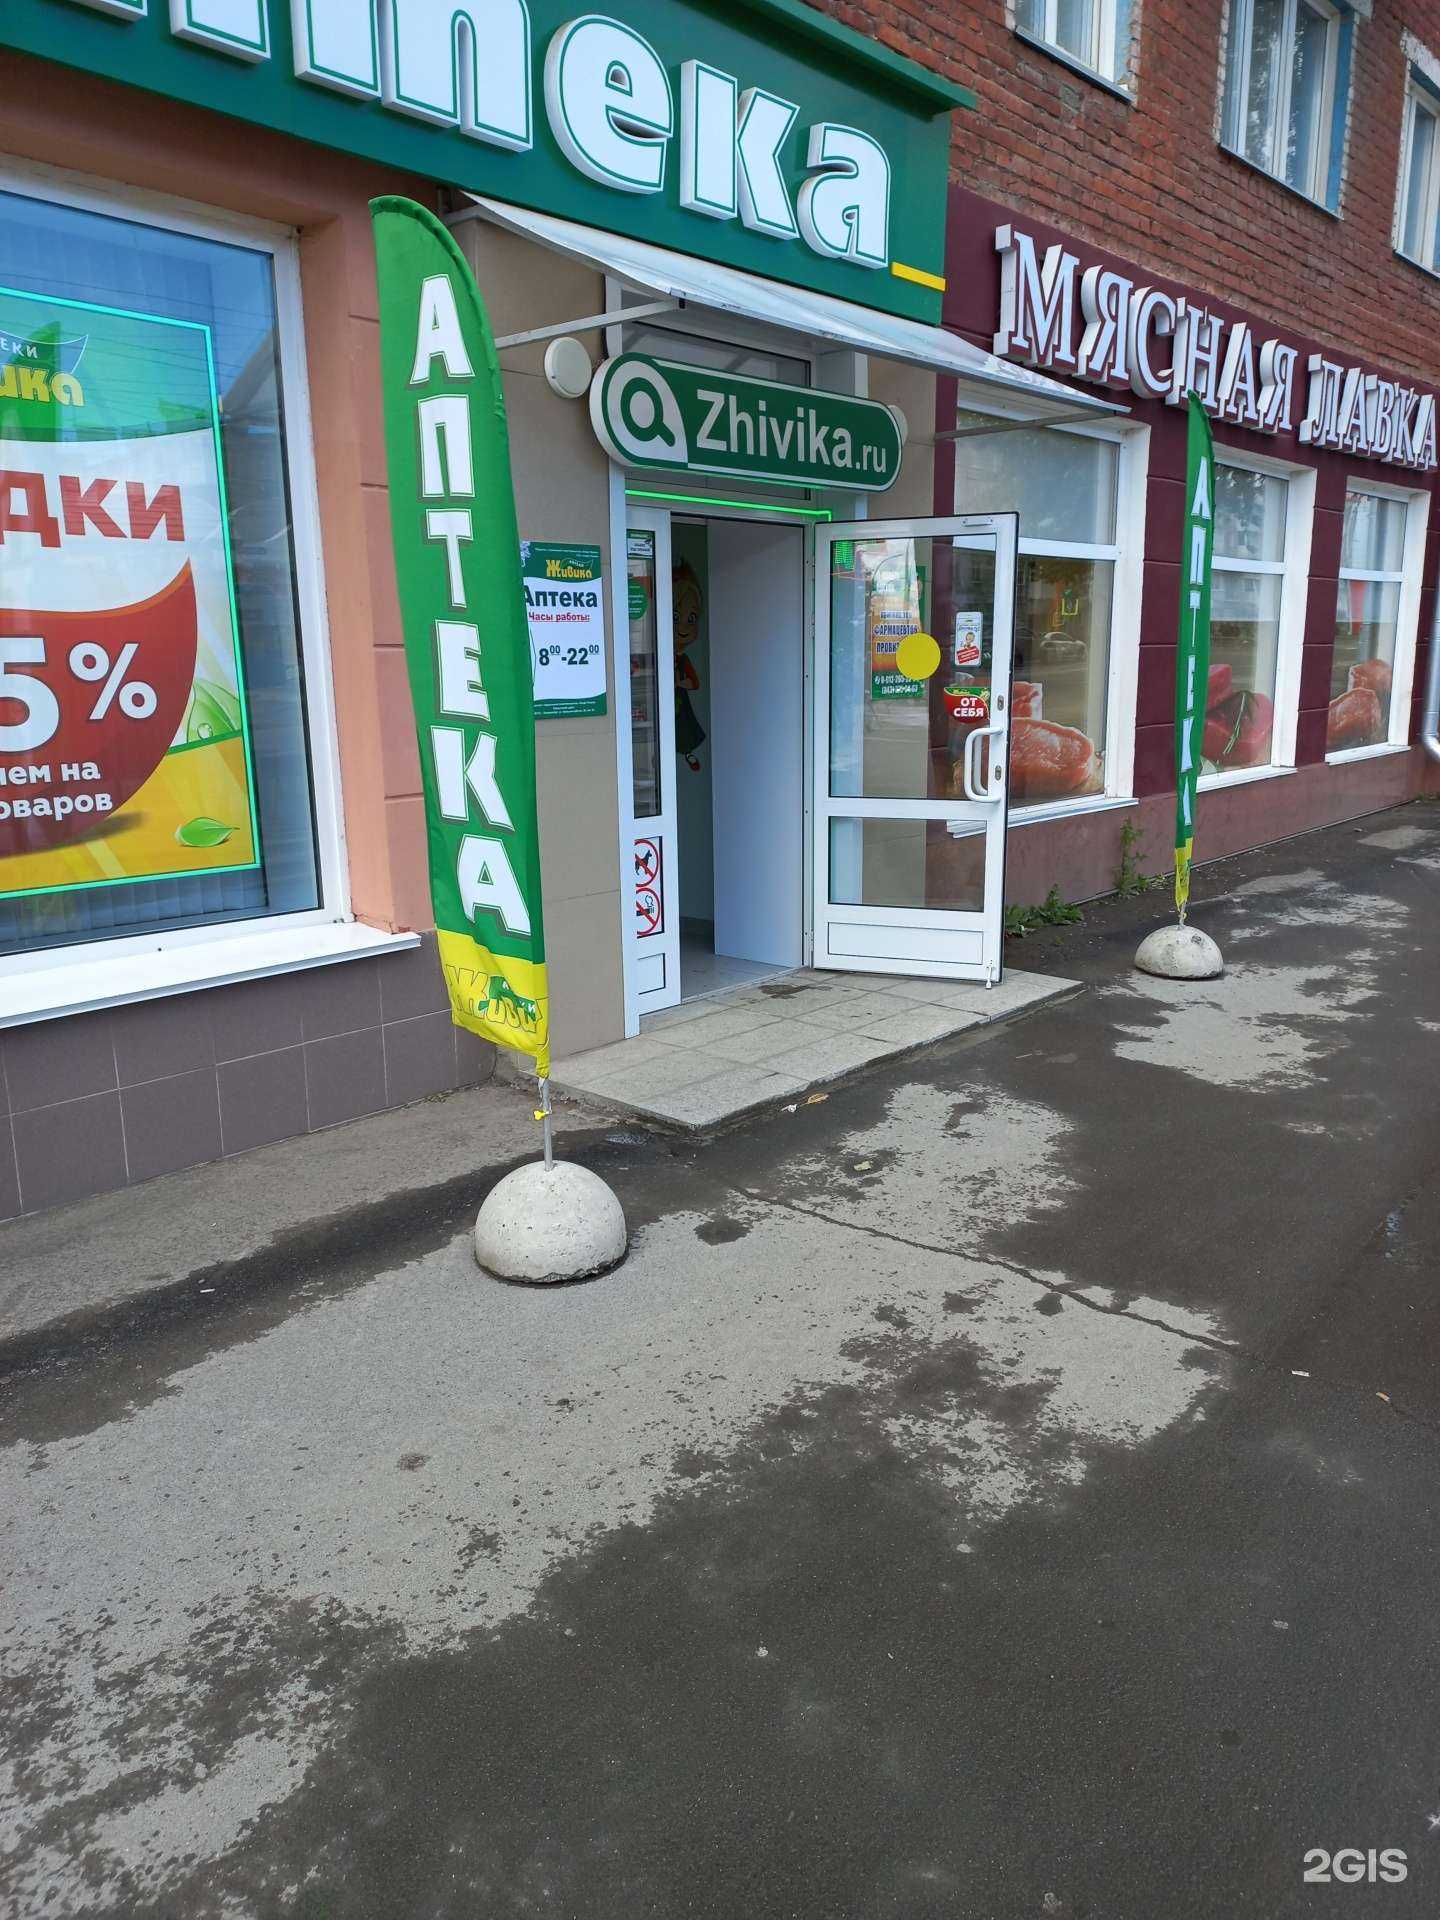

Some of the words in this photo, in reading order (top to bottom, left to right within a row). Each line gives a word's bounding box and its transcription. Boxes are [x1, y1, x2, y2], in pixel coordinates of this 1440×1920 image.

[993, 223, 1299, 435] МЯСНАЯ
[1299, 353, 1438, 471] ЛАВКА
[696, 388, 888, 474] Zhivika.ru
[408, 272, 532, 935] АПТЕКА
[528, 611, 554, 622] Часы
[556, 612, 591, 623] работы:
[953, 707, 984, 718] СЕБЯ
[960, 697, 978, 707] ОТ
[61, 761, 101, 782] на
